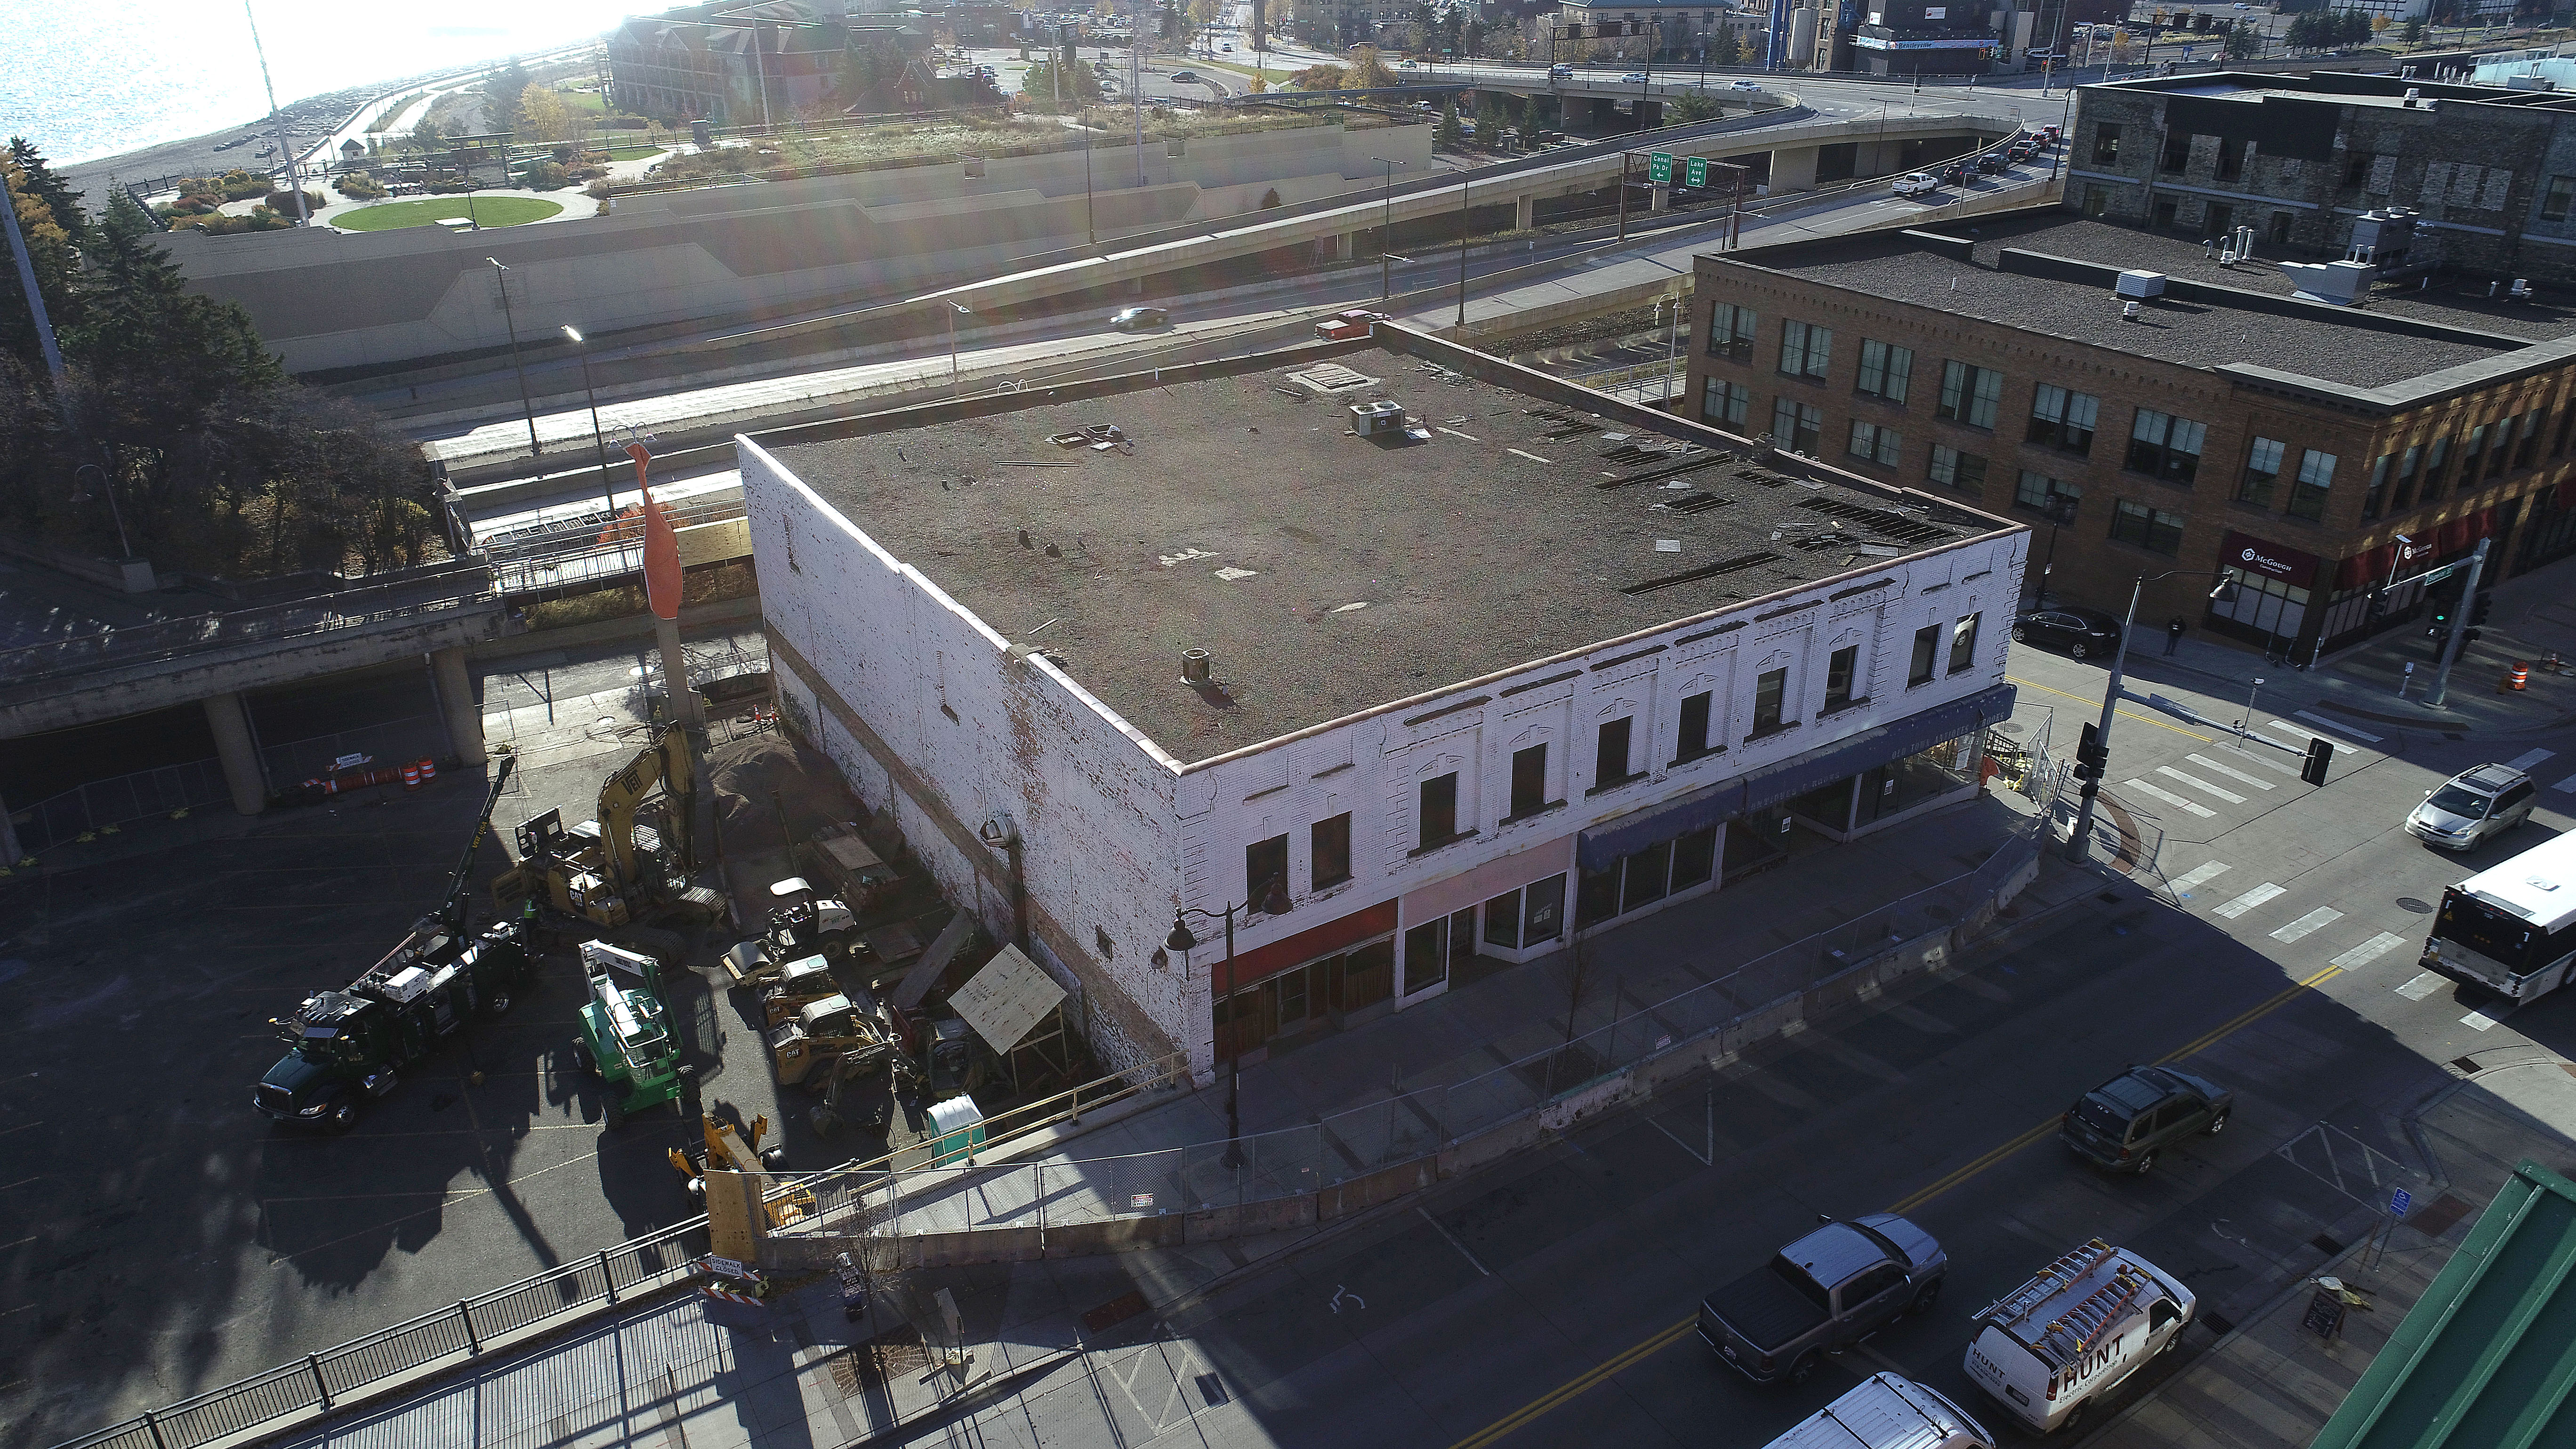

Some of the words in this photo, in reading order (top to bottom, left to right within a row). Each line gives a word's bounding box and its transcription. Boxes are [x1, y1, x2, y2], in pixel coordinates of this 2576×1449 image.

[570, 890, 583, 902] CAT
[769, 1006, 780, 1014] CAT
[787, 1048, 800, 1059] CAT
[712, 1258, 741, 1268] SIDEWALK
[716, 1265, 739, 1274] CLOSED
[1973, 1348, 2005, 1378] HUNT
[2064, 1333, 2124, 1393] HUNT
[2059, 1384, 2083, 1404] Electric
